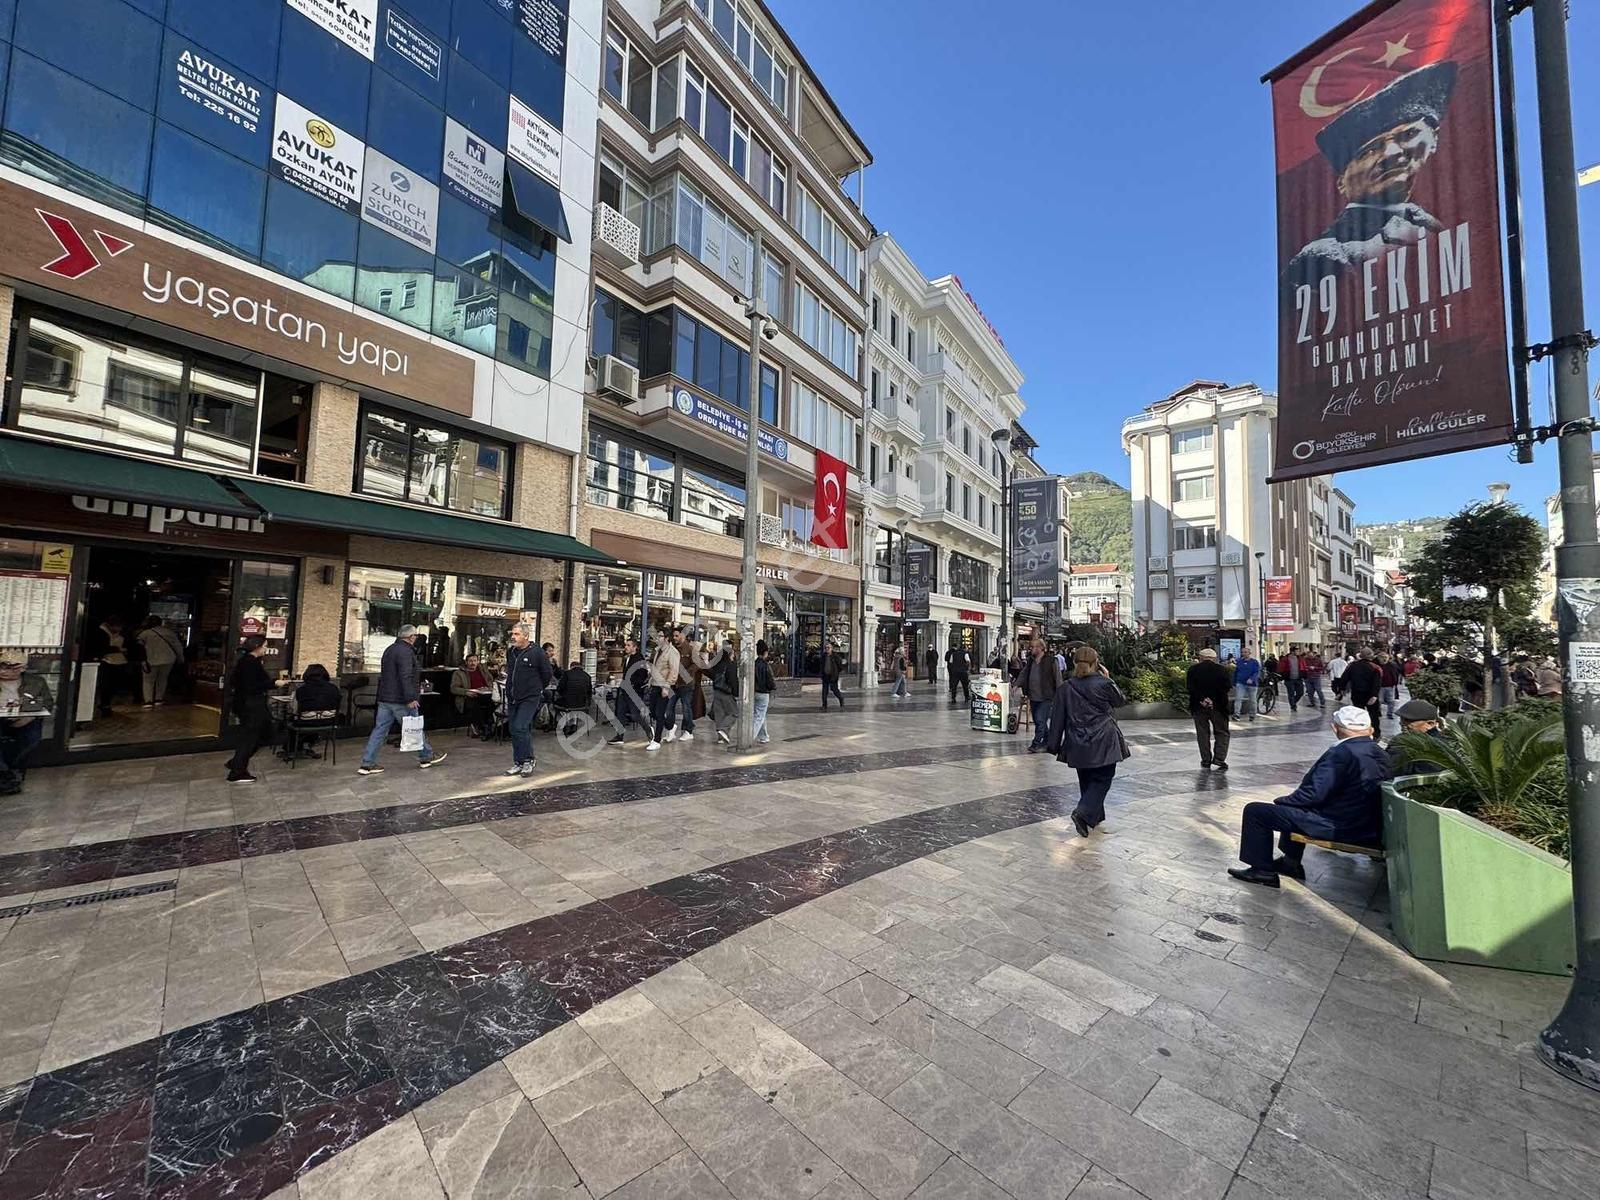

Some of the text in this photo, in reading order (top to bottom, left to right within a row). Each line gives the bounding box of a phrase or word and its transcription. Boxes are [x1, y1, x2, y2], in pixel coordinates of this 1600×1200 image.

[327, 0, 372, 29] KAT
[336, 13, 371, 44] SAĞLAM
[178, 50, 261, 104] AVUKAT
[209, 80, 233, 101] ÇİÇEK
[203, 99, 225, 116] 225
[227, 112, 241, 125] 16
[243, 120, 257, 134] 92
[277, 129, 358, 181] AVUKAT
[277, 144, 356, 195] Özkan AYDIN
[291, 170, 313, 187] 0452
[371, 182, 426, 220] ZURICH
[1295, 222, 1472, 344] 29 EKİM
[142, 261, 408, 376] yaşatan yapı
[1312, 303, 1452, 368] CUMHURİYET
[1331, 339, 1429, 388] BAYRAMI
[697, 400, 731, 423] BELEDİYE
[735, 417, 742, 429] İŞ
[1320, 387, 1368, 422] Kutlu
[697, 411, 718, 427] ORDU
[718, 421, 737, 436] ŞUBE
[756, 565, 789, 581] ZİRLER
